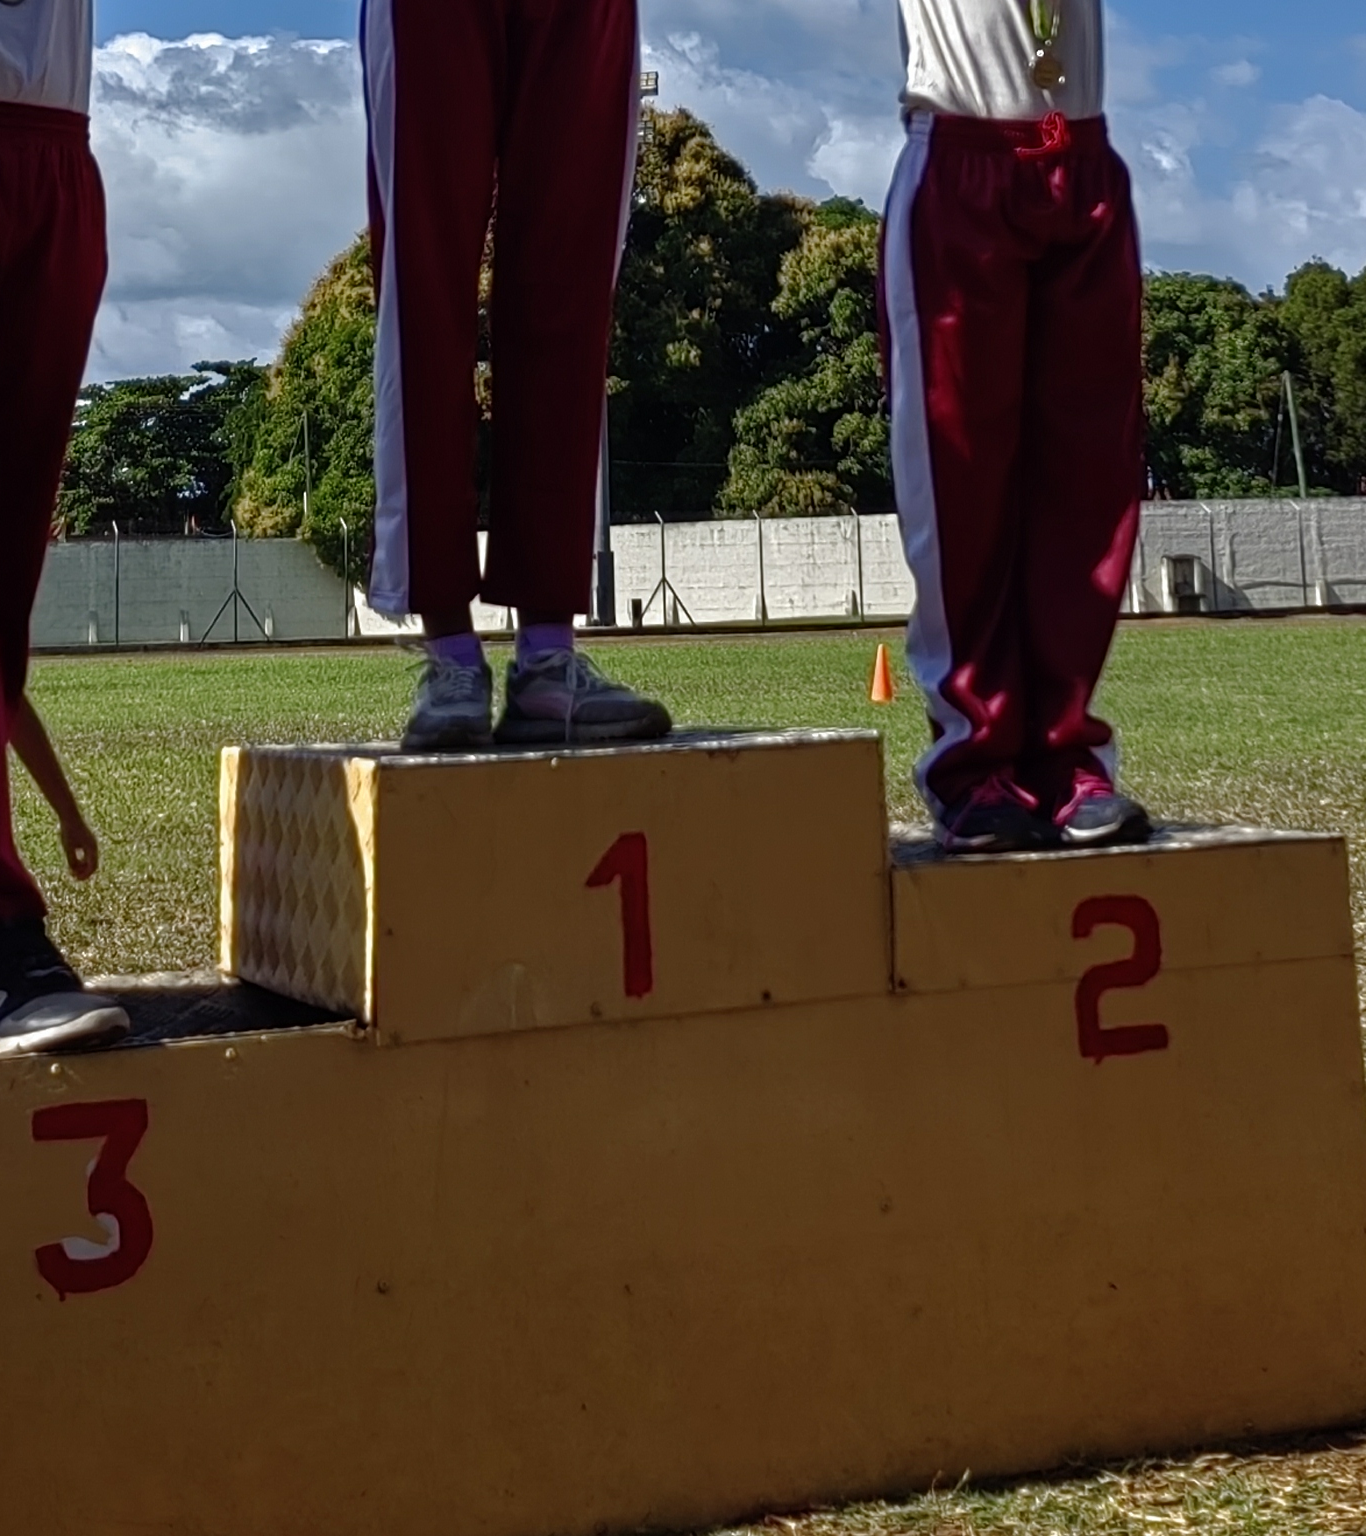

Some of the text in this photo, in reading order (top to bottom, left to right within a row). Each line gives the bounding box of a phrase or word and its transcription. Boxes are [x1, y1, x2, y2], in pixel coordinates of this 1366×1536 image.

[585, 831, 653, 998] 1
[1071, 894, 1169, 1062] 2
[31, 1098, 153, 1299] 3
